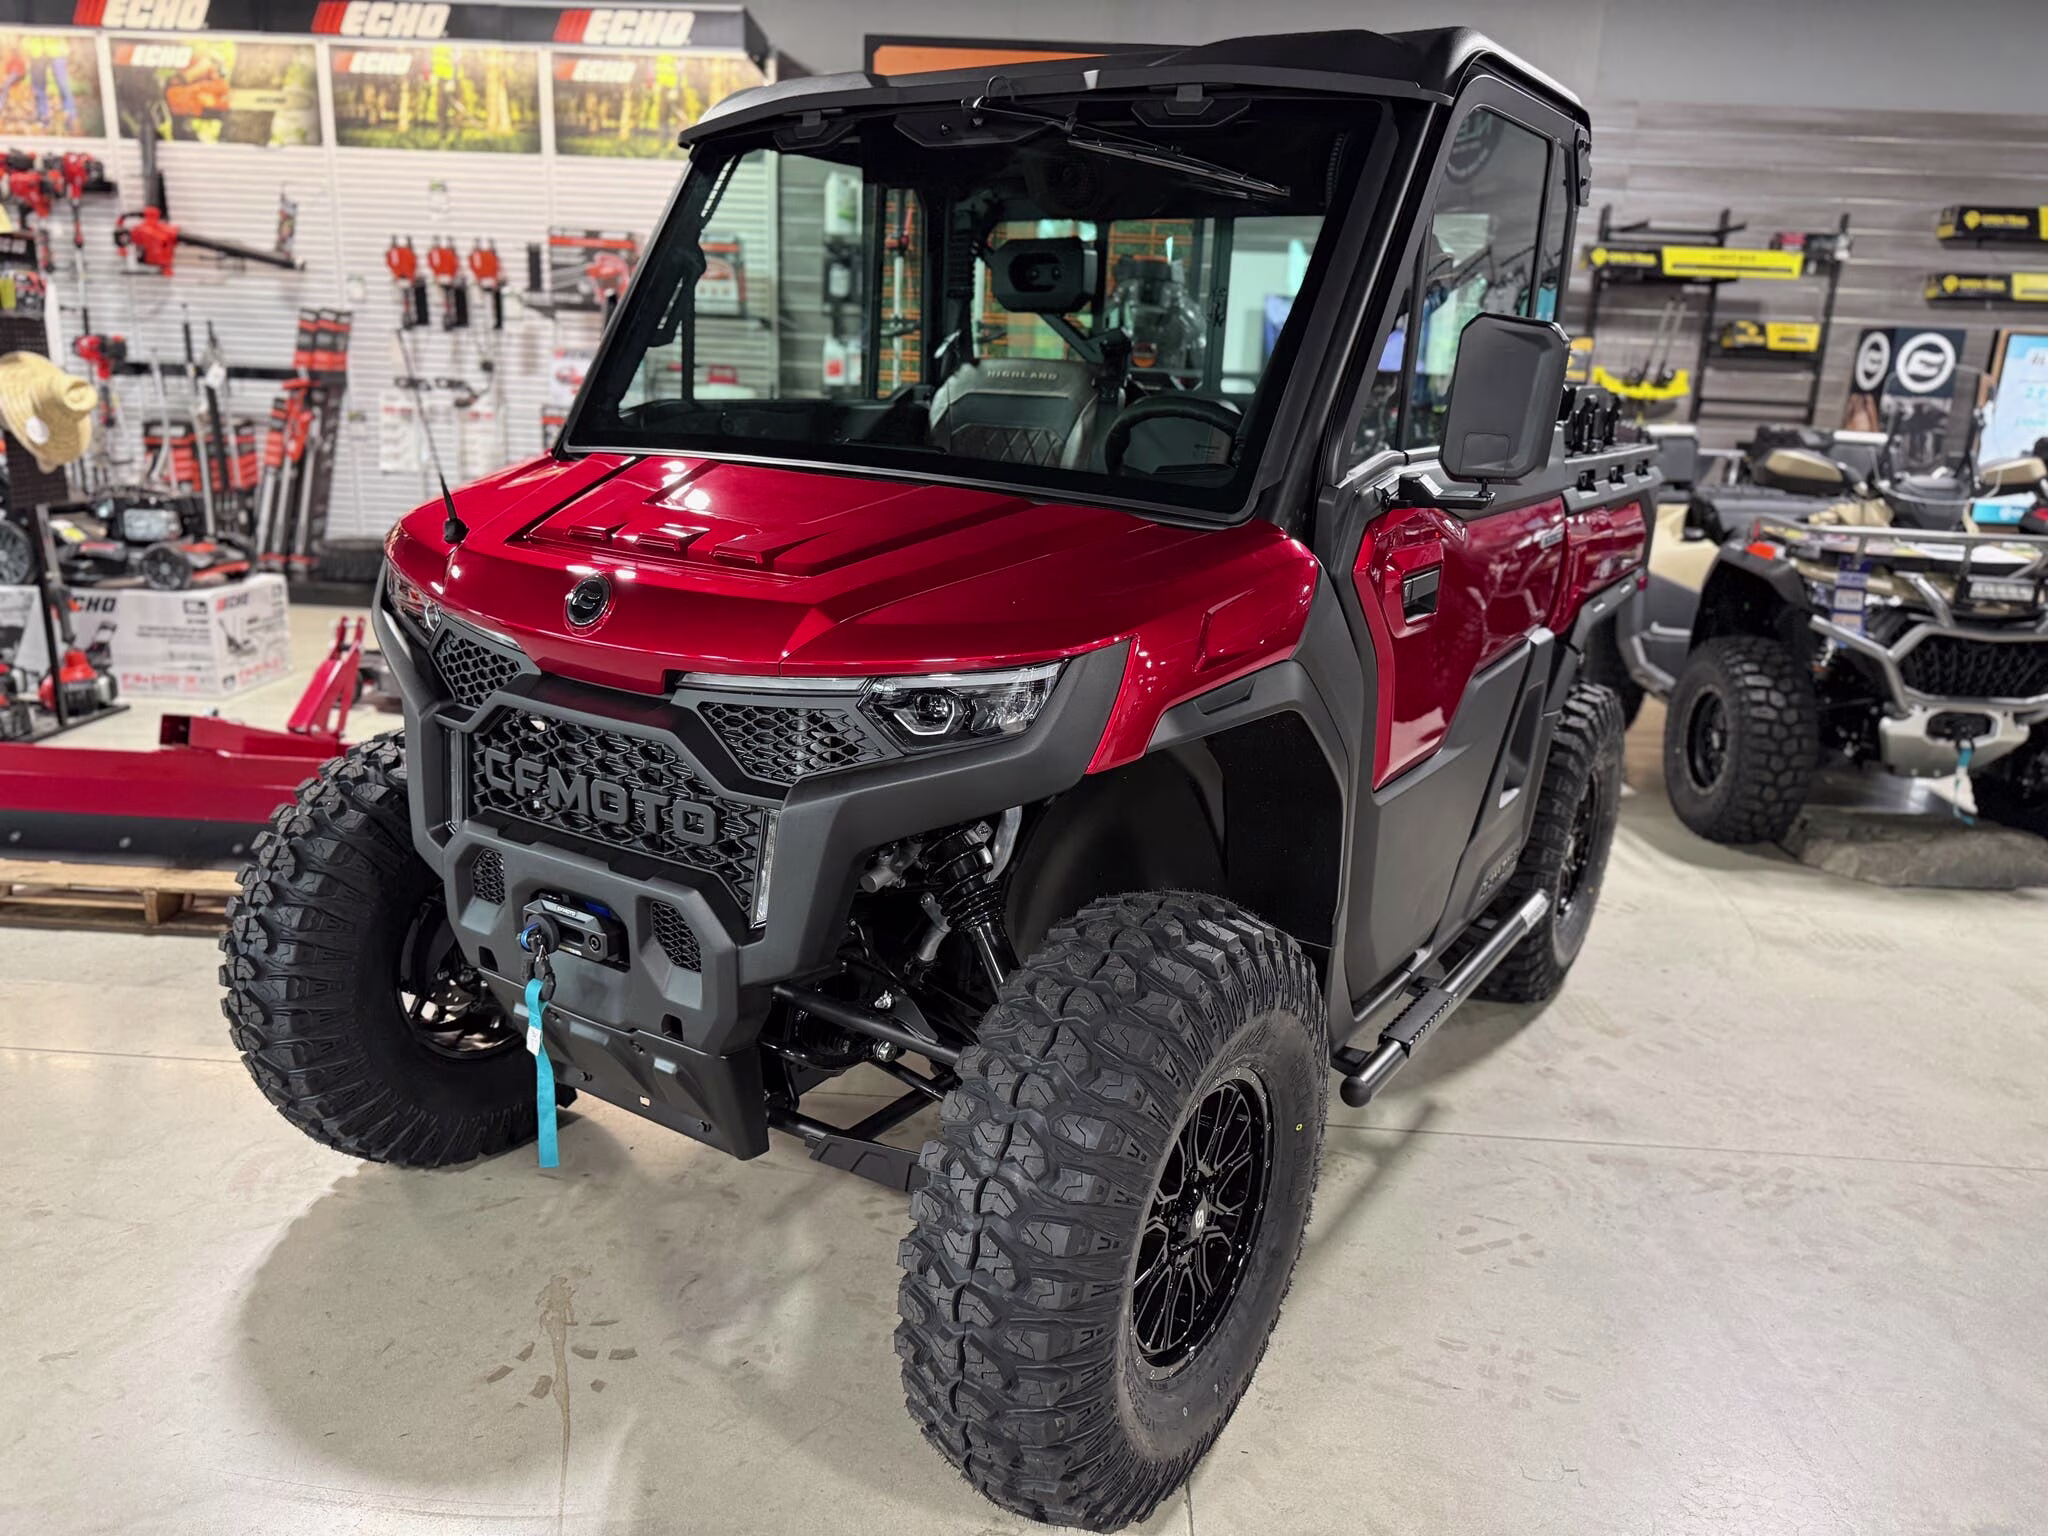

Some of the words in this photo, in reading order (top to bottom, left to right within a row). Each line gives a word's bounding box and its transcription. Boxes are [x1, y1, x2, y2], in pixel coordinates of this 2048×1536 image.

[101, 0, 208, 29] ECHO
[340, 2, 451, 38] ECHO
[583, 9, 695, 46] ECHO
[350, 52, 412, 76] ECHO
[987, 369, 1059, 380] HIGHLAND
[485, 748, 718, 846] CFMOTO
